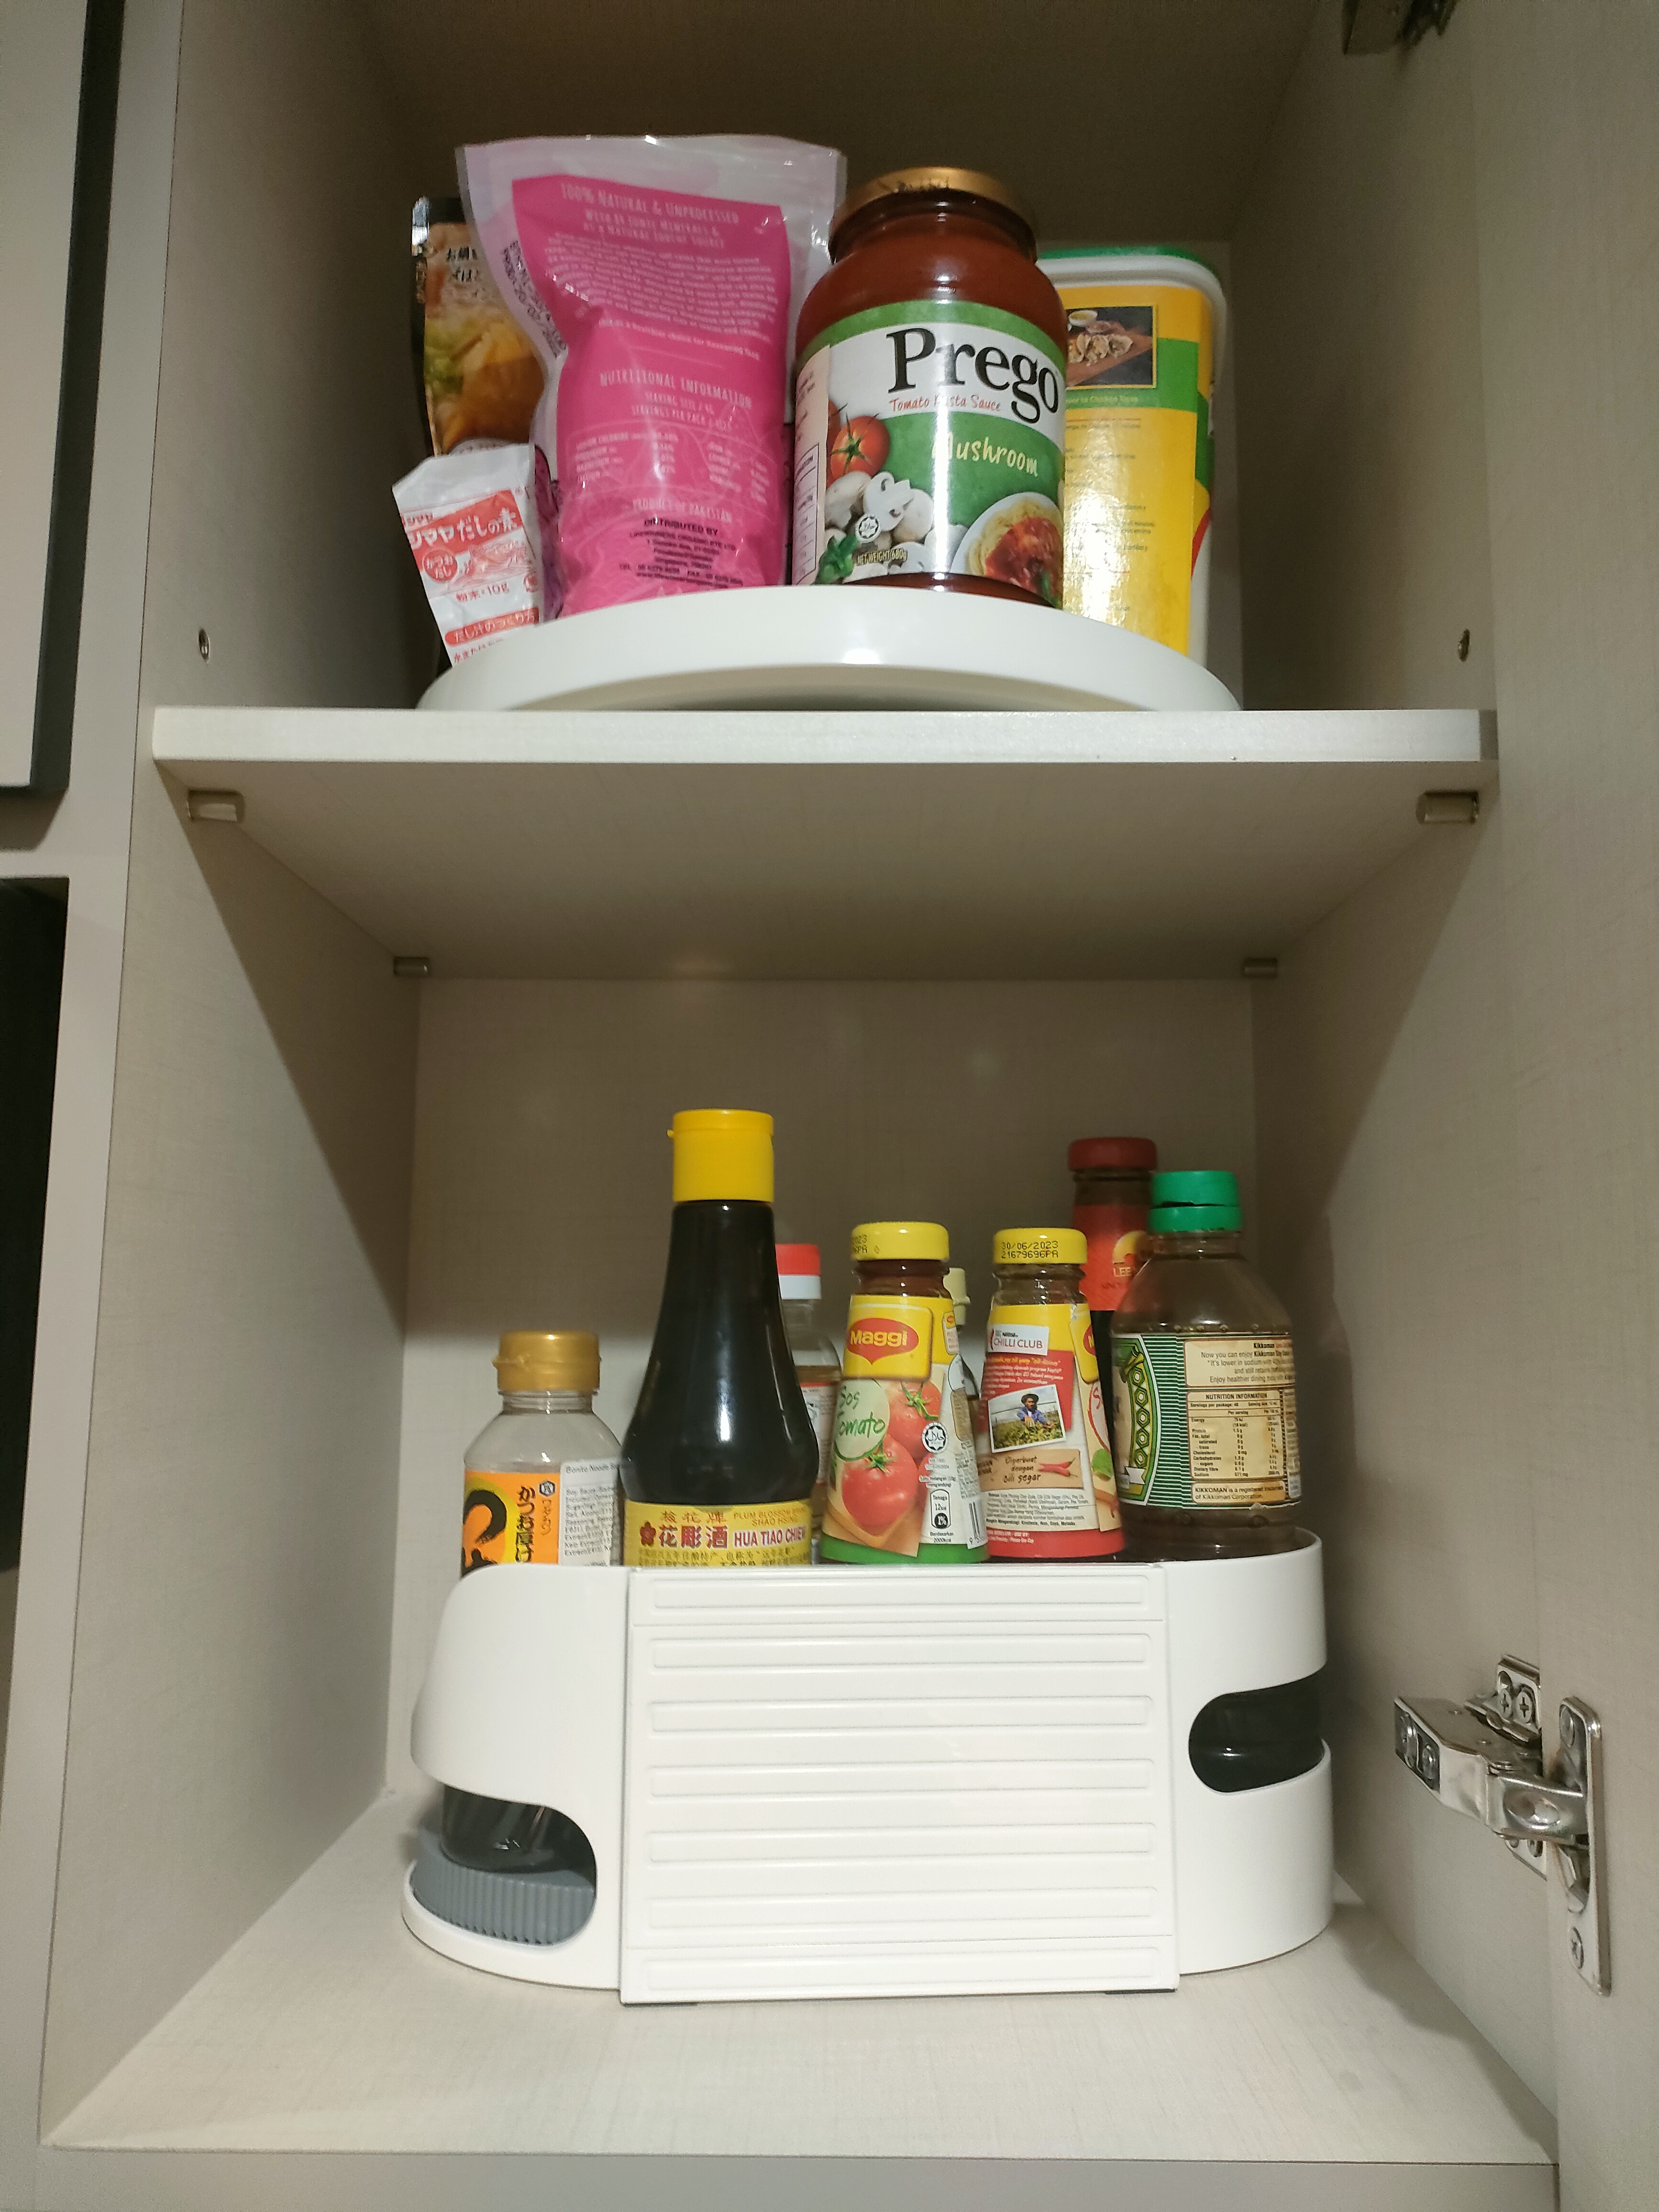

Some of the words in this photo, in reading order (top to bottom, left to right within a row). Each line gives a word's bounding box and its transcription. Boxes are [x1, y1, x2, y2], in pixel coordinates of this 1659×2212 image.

[886, 328, 1059, 424] Prego
[599, 368, 675, 390] NUTRITIONAL
[680, 376, 752, 409] INFORMATION
[889, 395, 930, 412] Tomato
[971, 394, 1001, 411] Sauce
[868, 550, 891, 564] WEIGHT
[891, 547, 908, 562] 680g
[1001, 1241, 1059, 1250] 30/06/2023
[1113, 1267, 1132, 1278] LEE
[850, 1330, 908, 1347] Maggi
[994, 1338, 1015, 1348] CHILLI
[1017, 1339, 1043, 1348] CLUB
[839, 1386, 860, 1410] Sos
[837, 1411, 885, 1438] Tomato
[1005, 1455, 1038, 1463] Diperbuat
[1018, 1473, 1041, 1484] segar
[733, 1510, 757, 1520] PLUM
[752, 1517, 775, 1527] SHAO
[937, 1515, 947, 1526] 1%
[734, 1530, 758, 1547] HUA
[761, 1528, 784, 1545] TIAO
